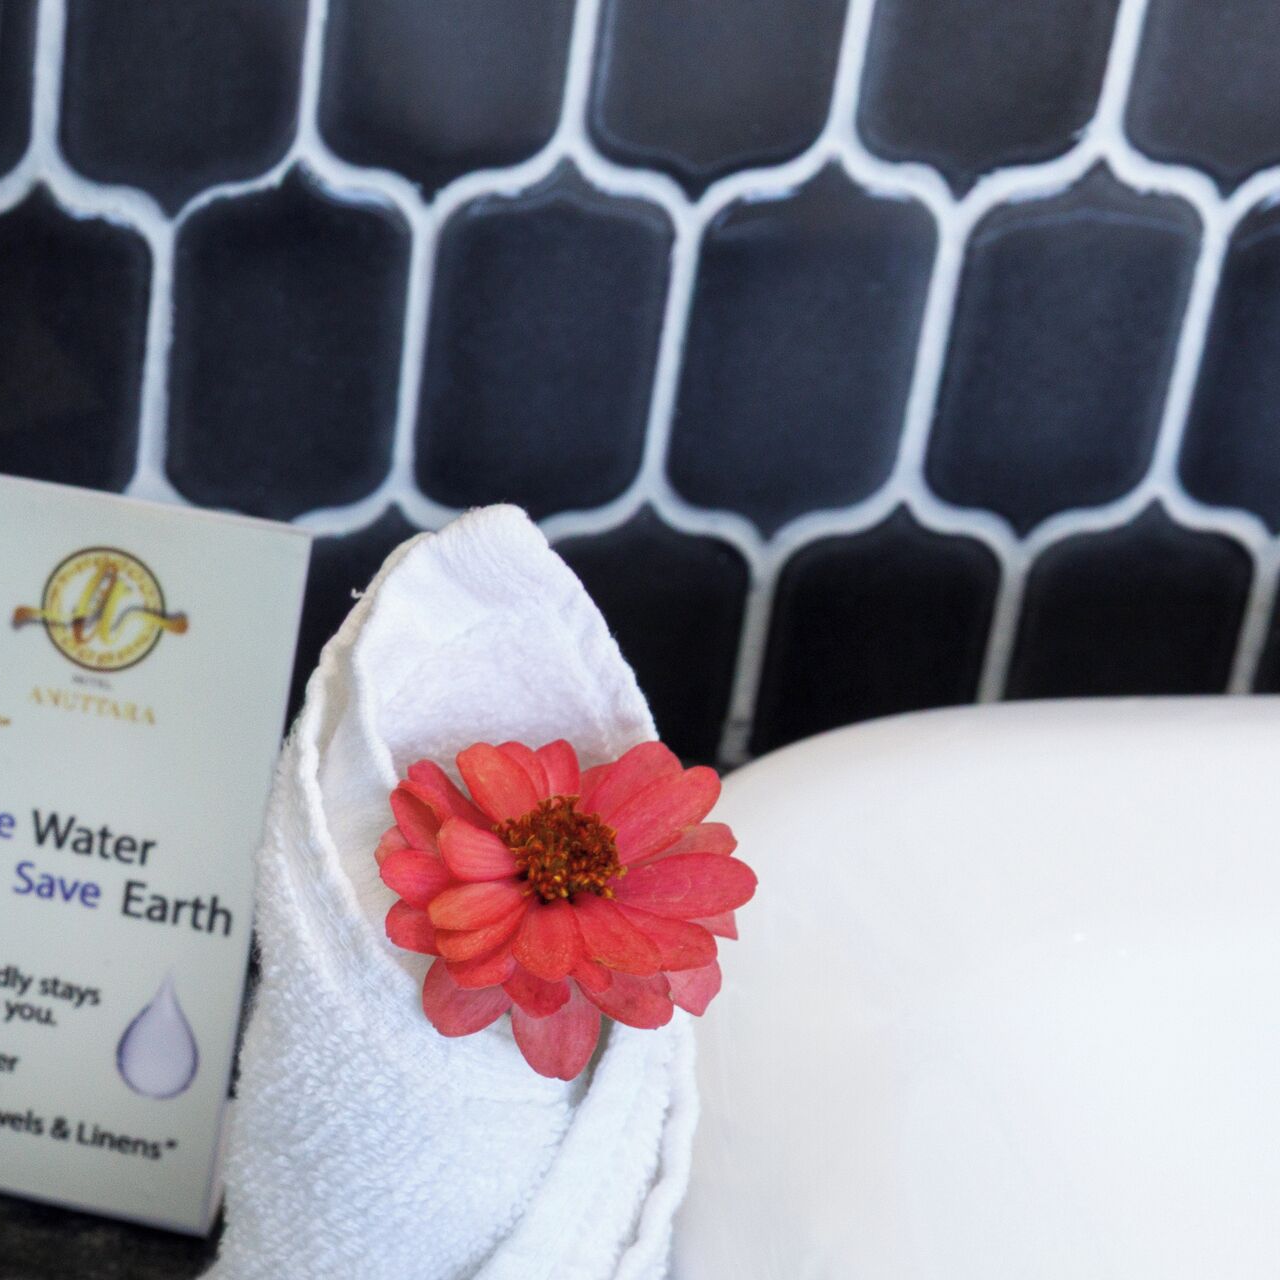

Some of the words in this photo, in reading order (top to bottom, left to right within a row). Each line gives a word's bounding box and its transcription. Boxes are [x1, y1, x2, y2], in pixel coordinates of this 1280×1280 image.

[33, 809, 157, 867] Water
[12, 861, 101, 908] Save
[120, 880, 233, 937] Earth
[39, 972, 101, 1008] stays
[4, 997, 58, 1028] you.
[49, 1116, 71, 1141] &
